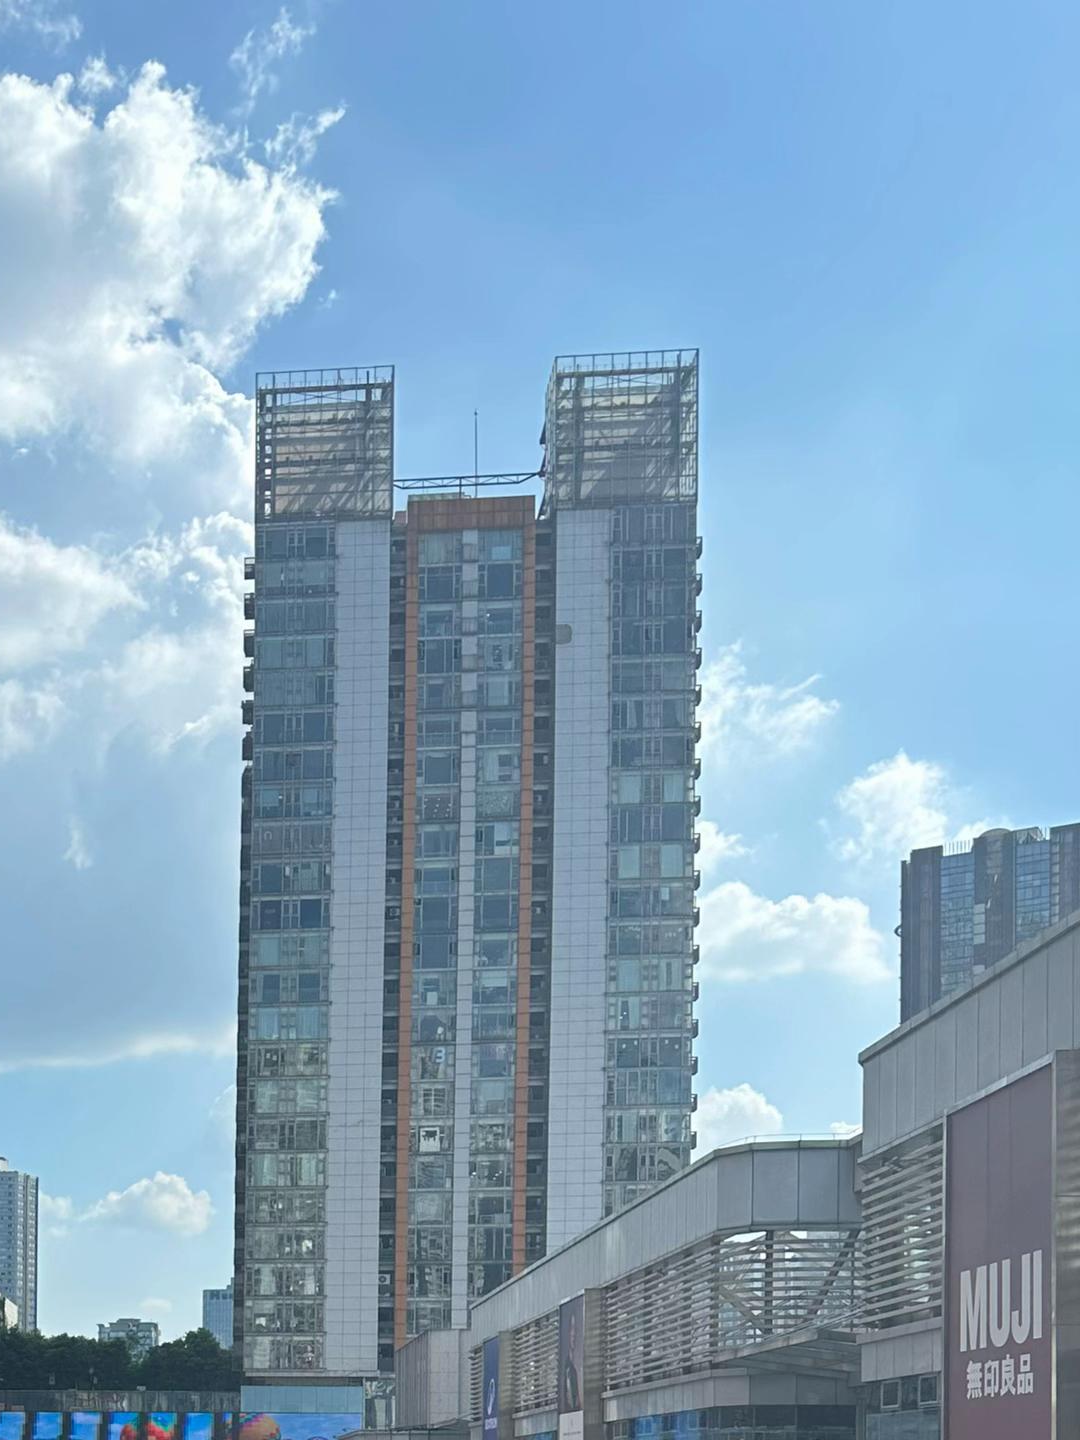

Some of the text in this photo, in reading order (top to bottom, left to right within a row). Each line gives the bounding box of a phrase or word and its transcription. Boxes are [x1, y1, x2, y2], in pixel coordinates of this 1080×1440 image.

[960, 1249, 1042, 1352] MUJI
[967, 1354, 1033, 1399] 無印良品
